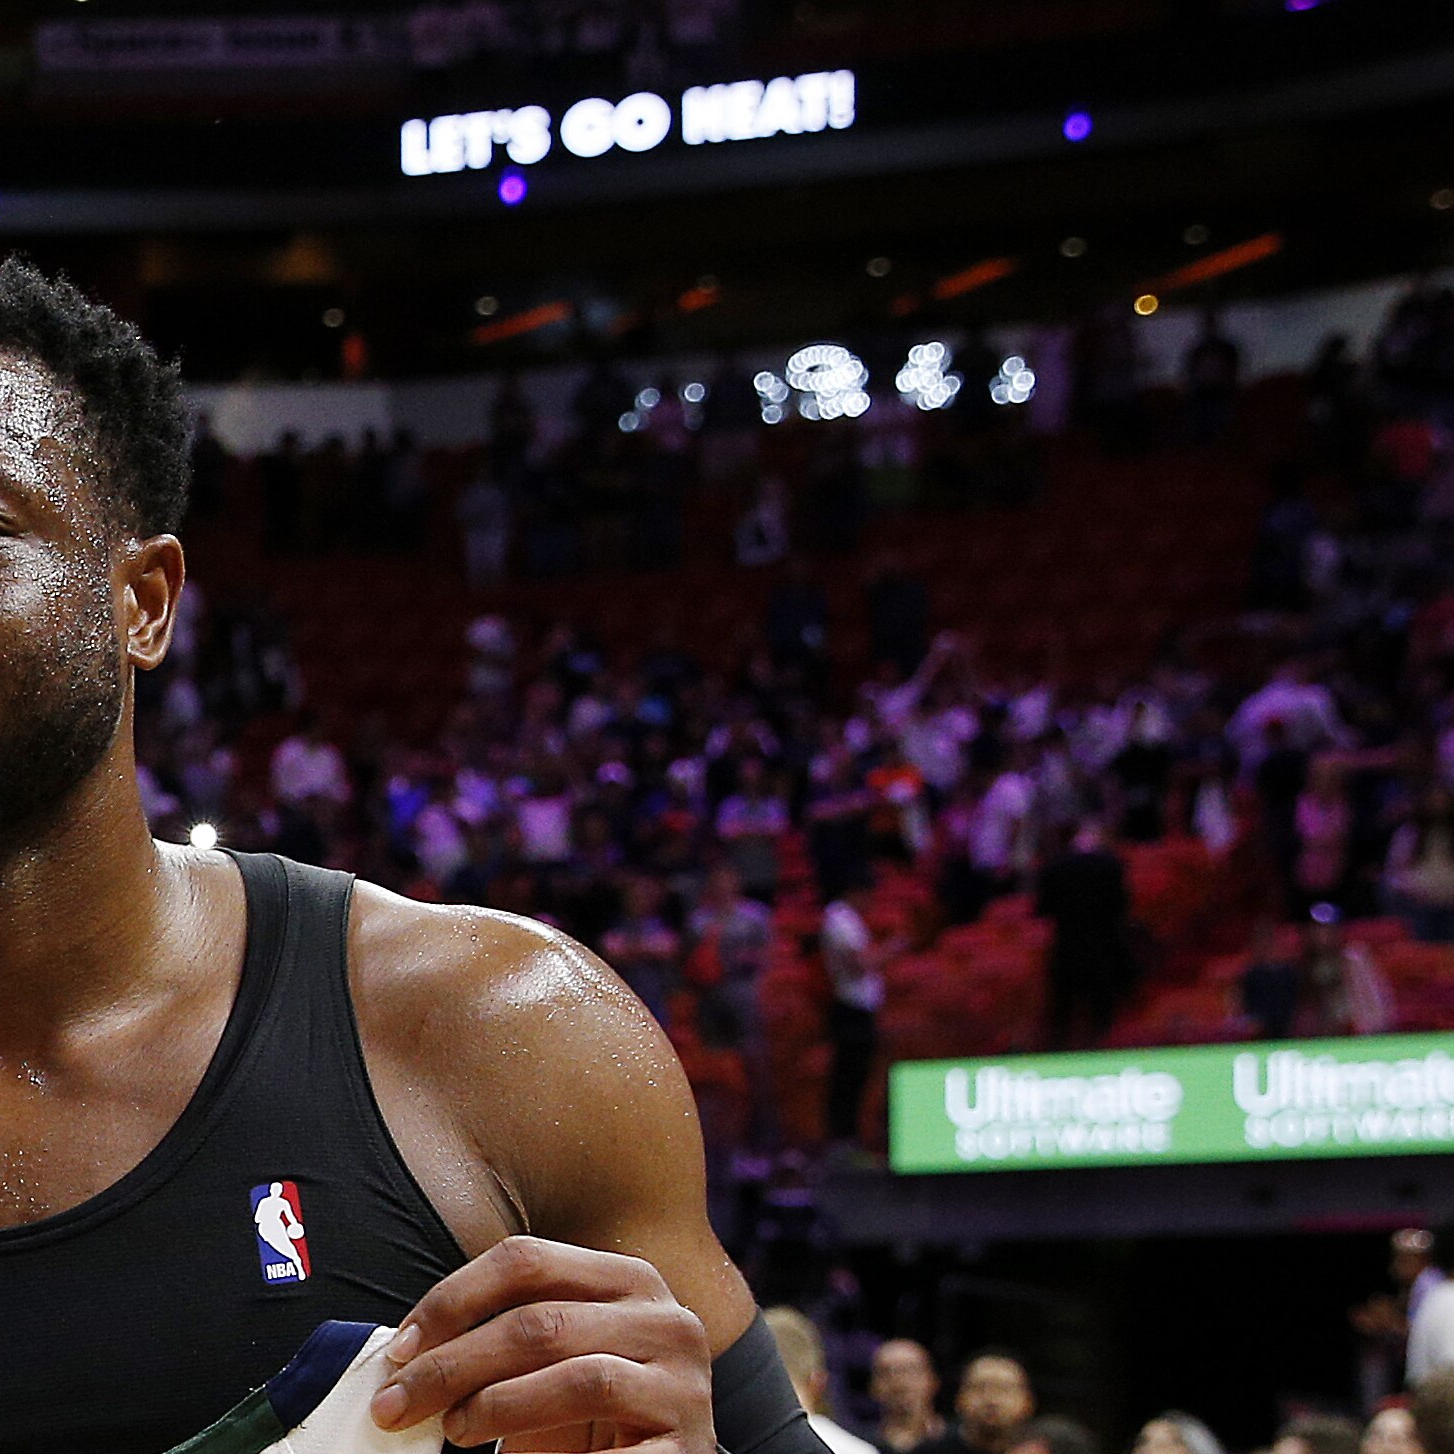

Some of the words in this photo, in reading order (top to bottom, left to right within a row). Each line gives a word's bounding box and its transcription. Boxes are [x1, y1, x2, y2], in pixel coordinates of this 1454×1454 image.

[401, 105, 551, 176] LET'S
[560, 92, 671, 157] GO
[682, 69, 855, 145] HEAT!
[1245, 1108, 1454, 1148] SOFTWAR
[266, 1261, 297, 1280] NBA
